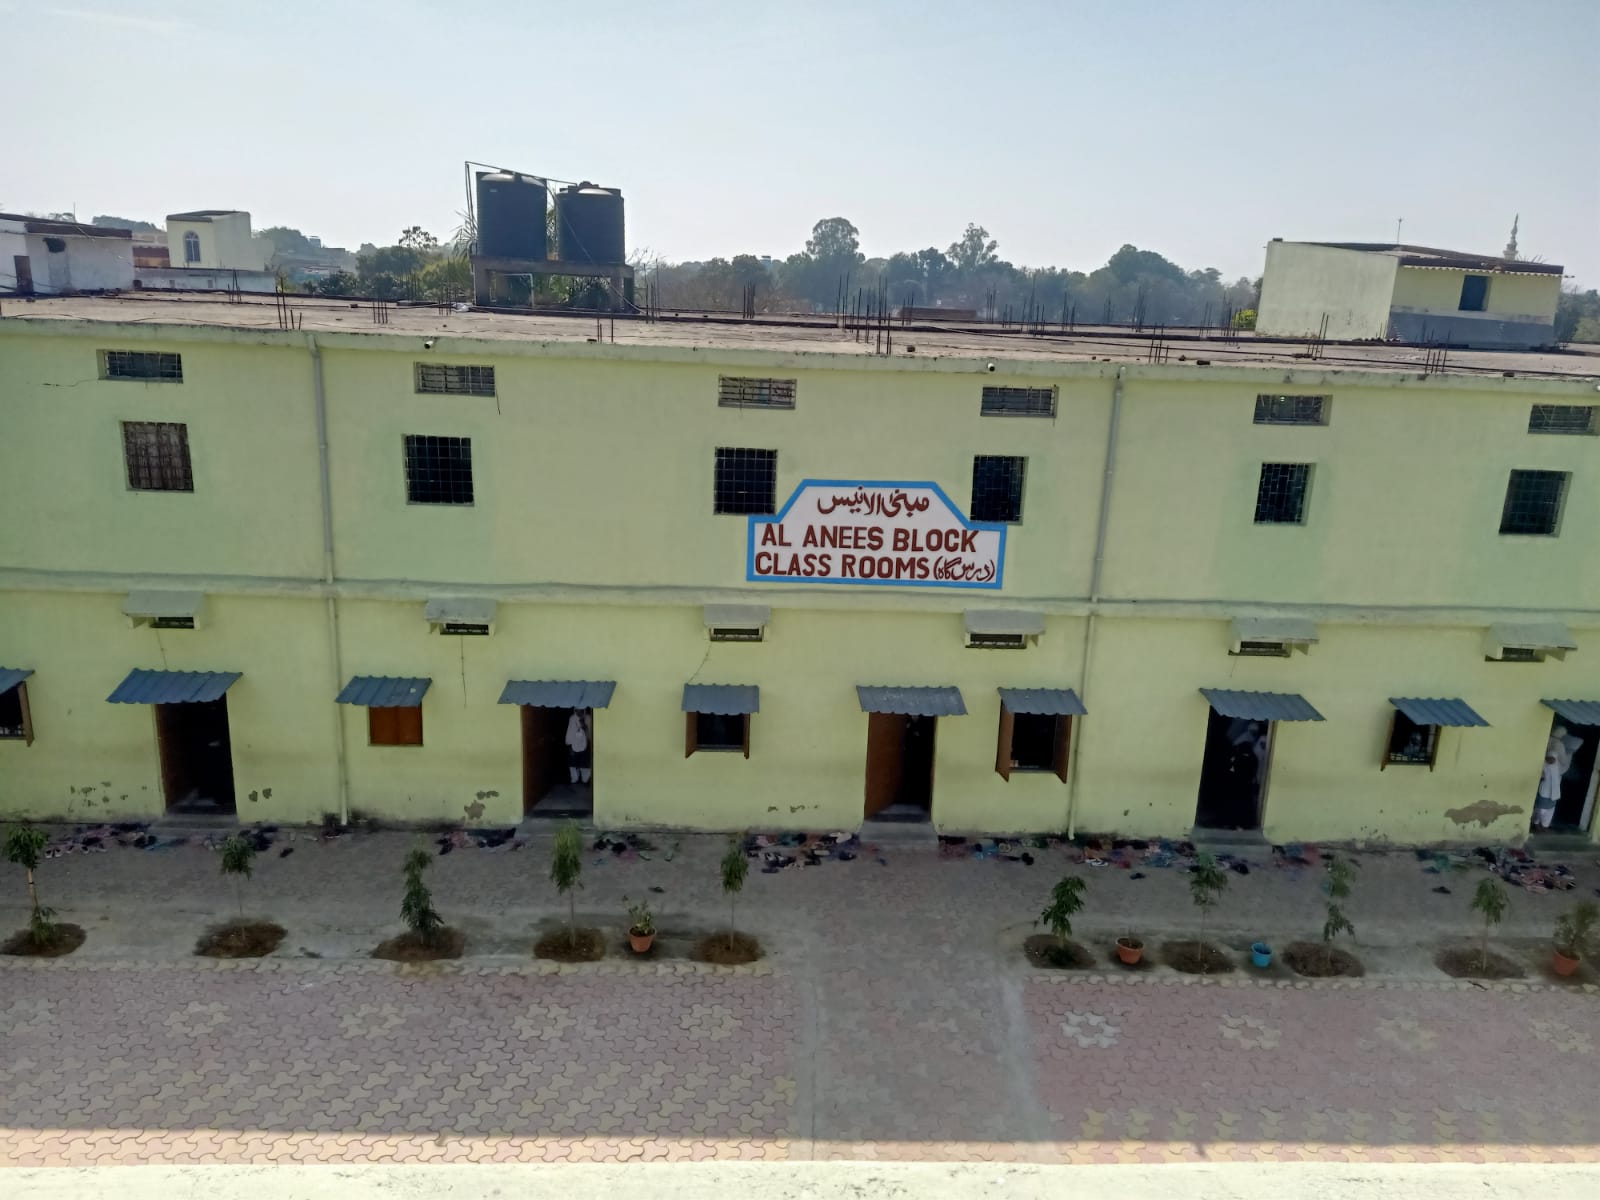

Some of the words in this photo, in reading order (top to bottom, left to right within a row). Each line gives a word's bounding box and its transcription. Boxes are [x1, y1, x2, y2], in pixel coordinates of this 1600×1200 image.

[761, 523, 792, 548] AL
[802, 524, 884, 551] ANEES
[892, 528, 979, 553] BLOCK
[755, 551, 832, 577] CLASS
[841, 554, 930, 579] ROOMS
